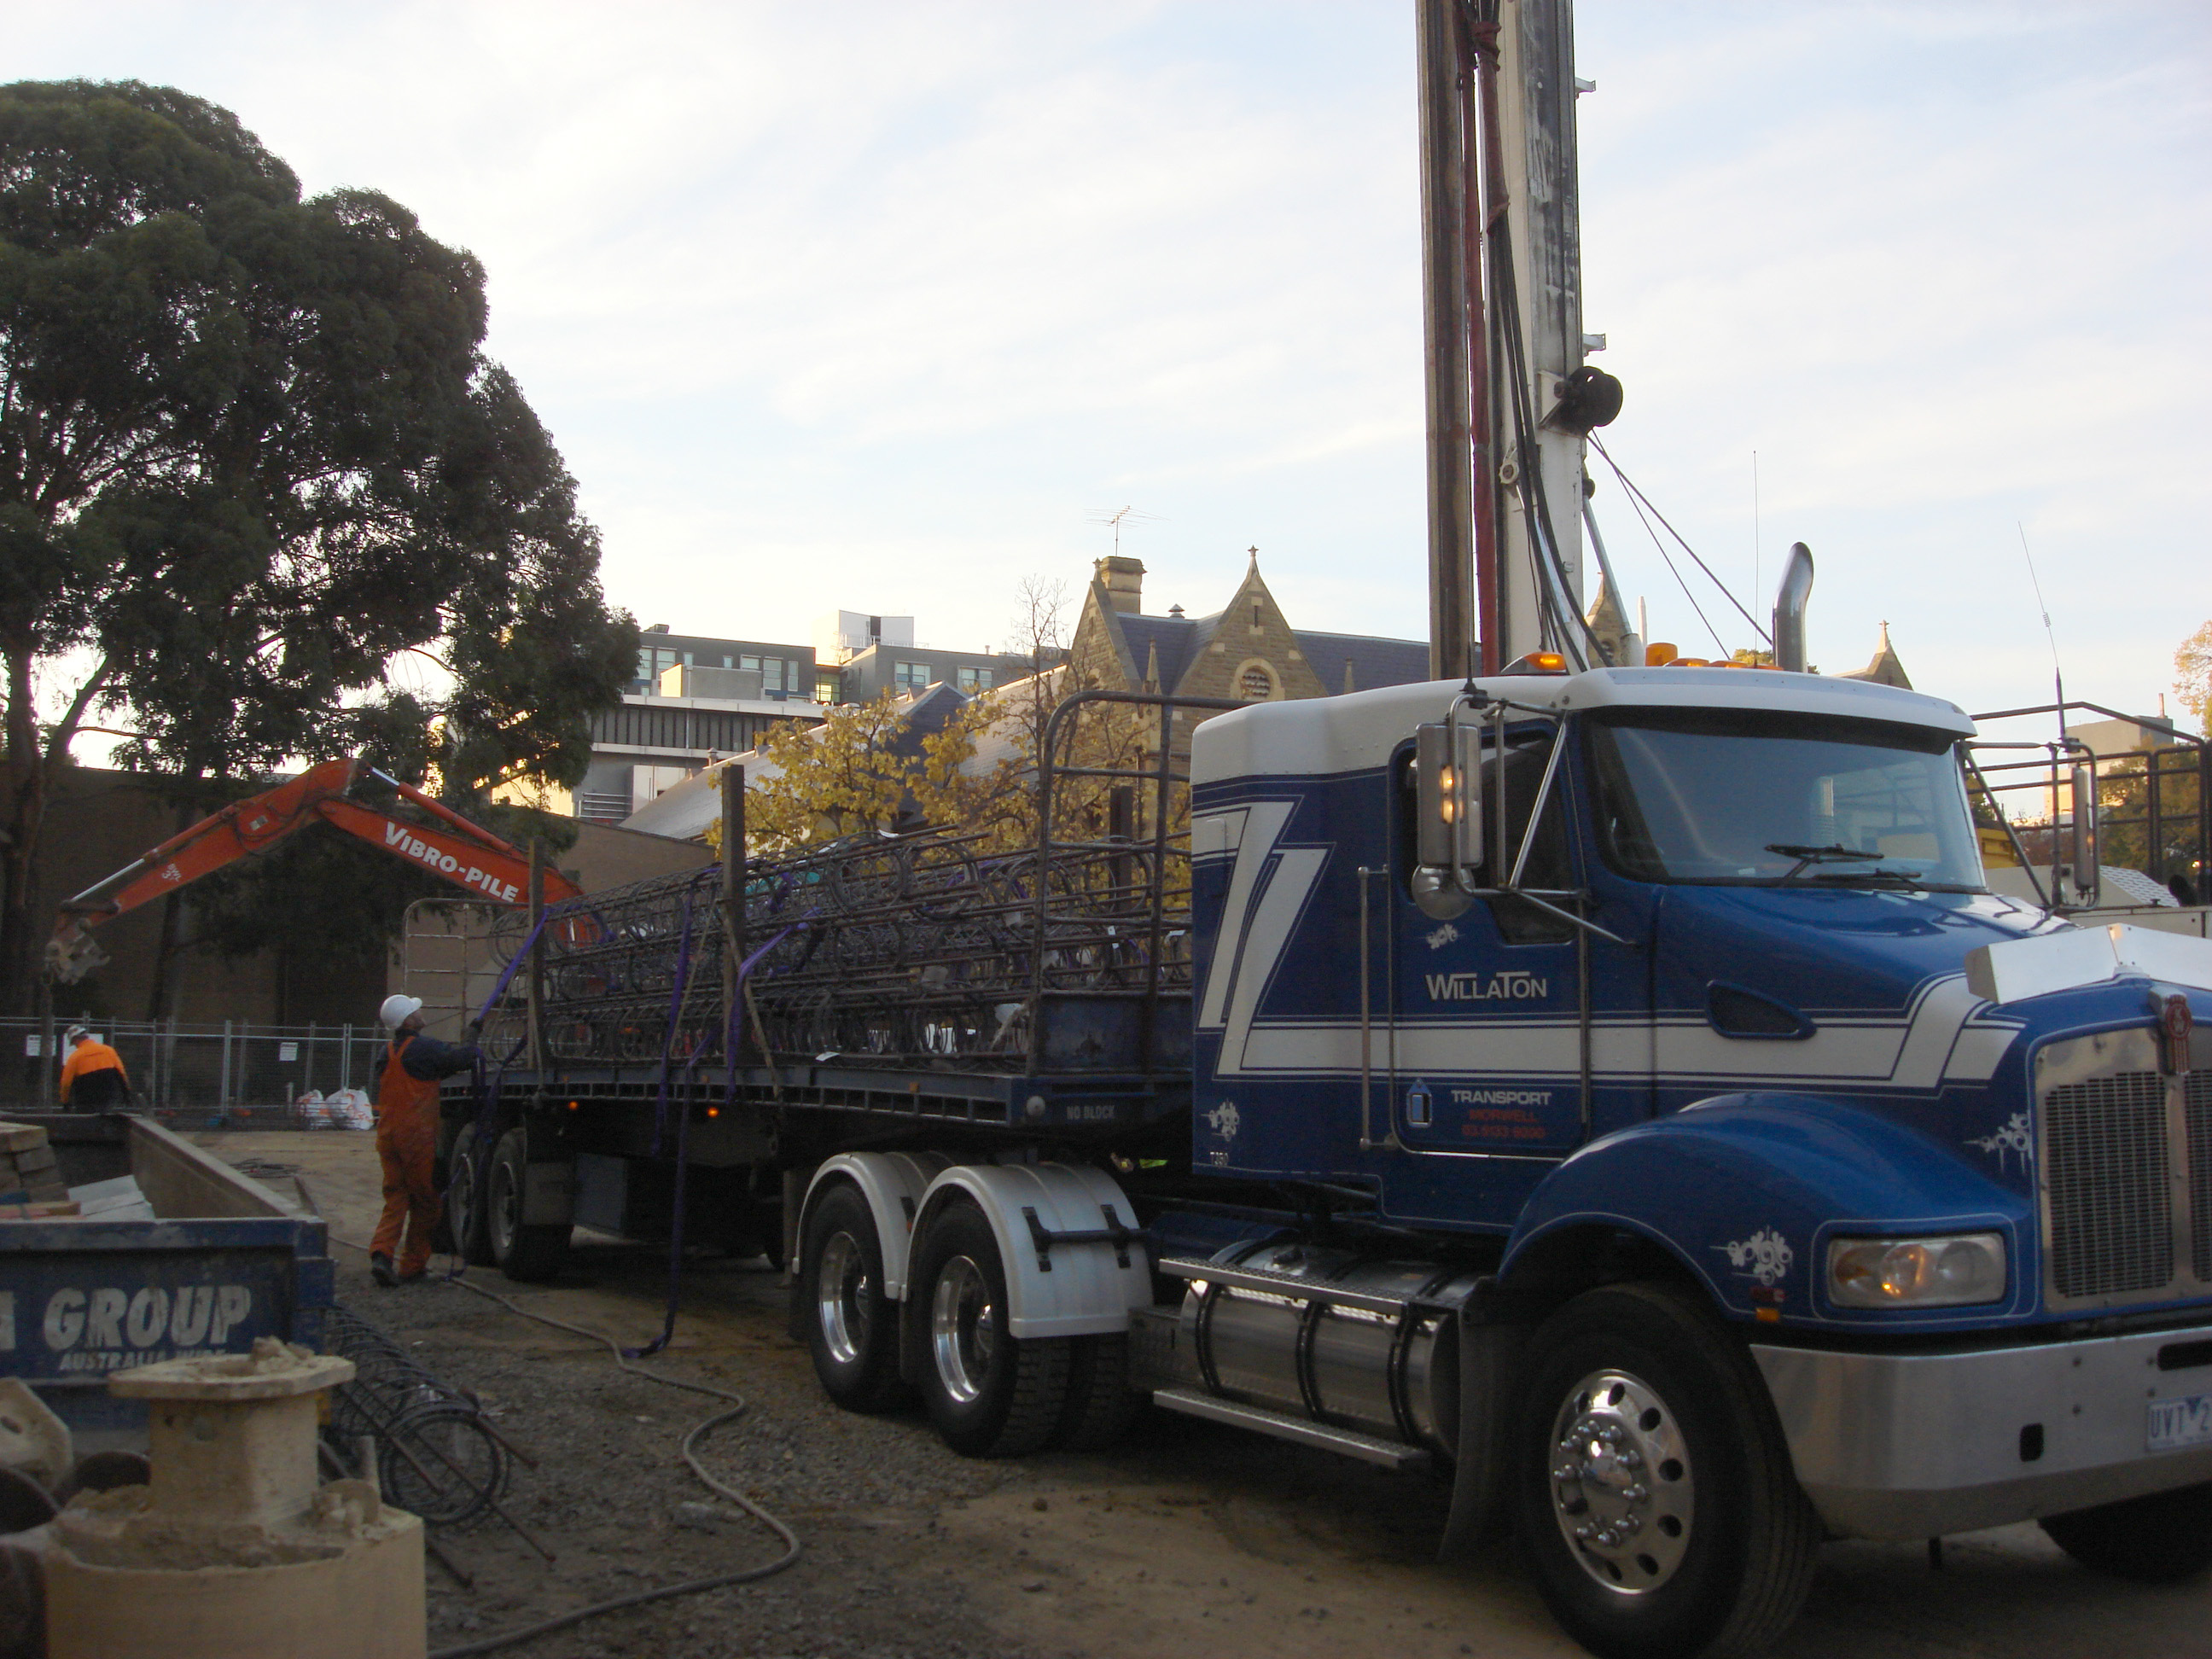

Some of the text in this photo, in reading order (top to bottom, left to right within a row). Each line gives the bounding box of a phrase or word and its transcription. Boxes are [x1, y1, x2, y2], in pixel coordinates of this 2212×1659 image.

[384, 821, 519, 902] VIBRO-PILE
[1452, 1090, 1551, 1105] TRANSPORT
[44, 1285, 251, 1350] GROUP
